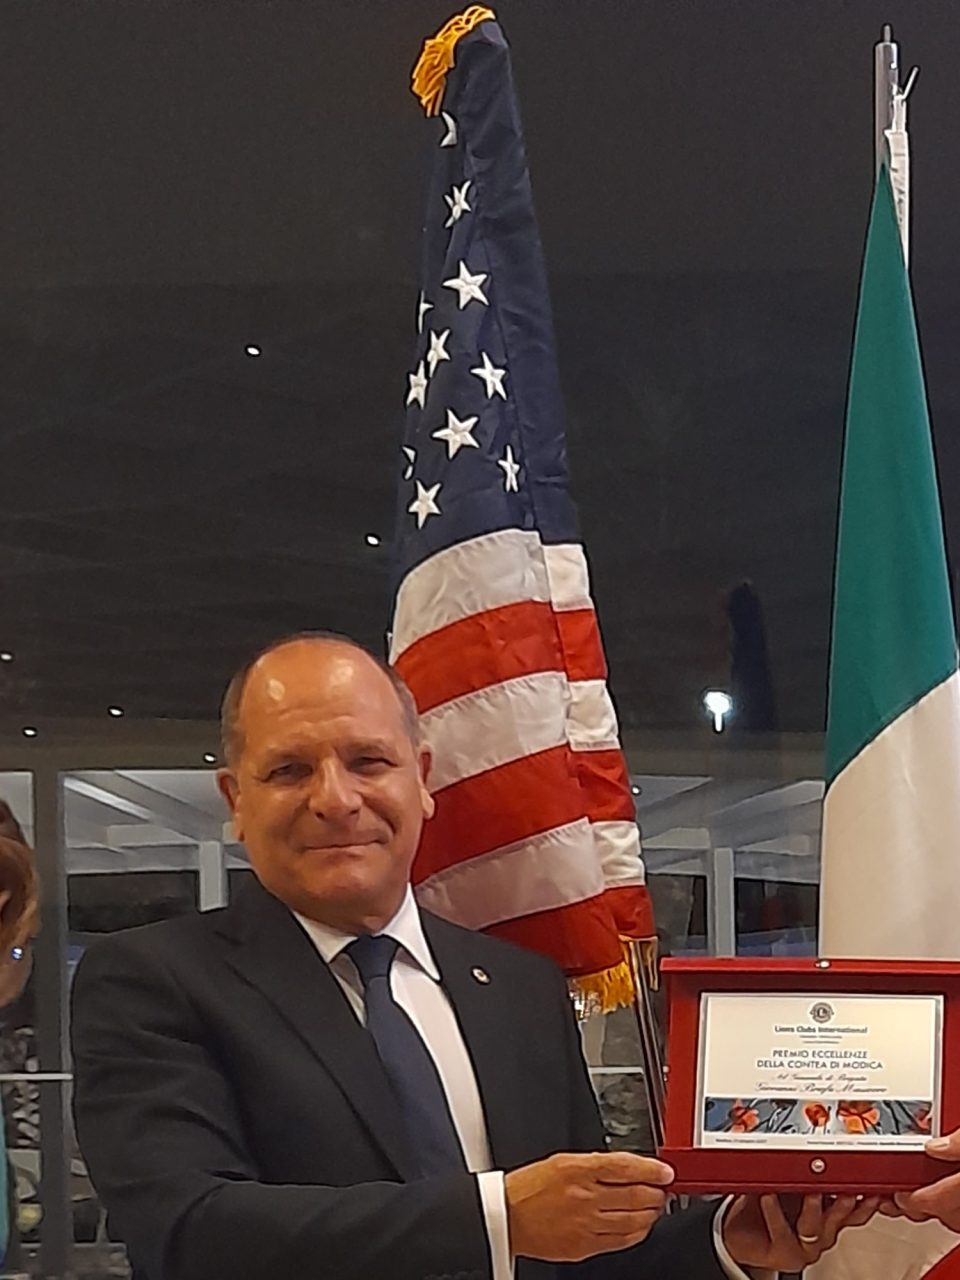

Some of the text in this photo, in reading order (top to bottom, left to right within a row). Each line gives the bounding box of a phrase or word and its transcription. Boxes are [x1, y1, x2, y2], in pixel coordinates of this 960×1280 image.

[818, 1026, 868, 1034] International
[772, 1049, 868, 1059] PREMIO ECCELLENZE
[756, 1060, 883, 1070] DELLA CONTEA DI MODICA
